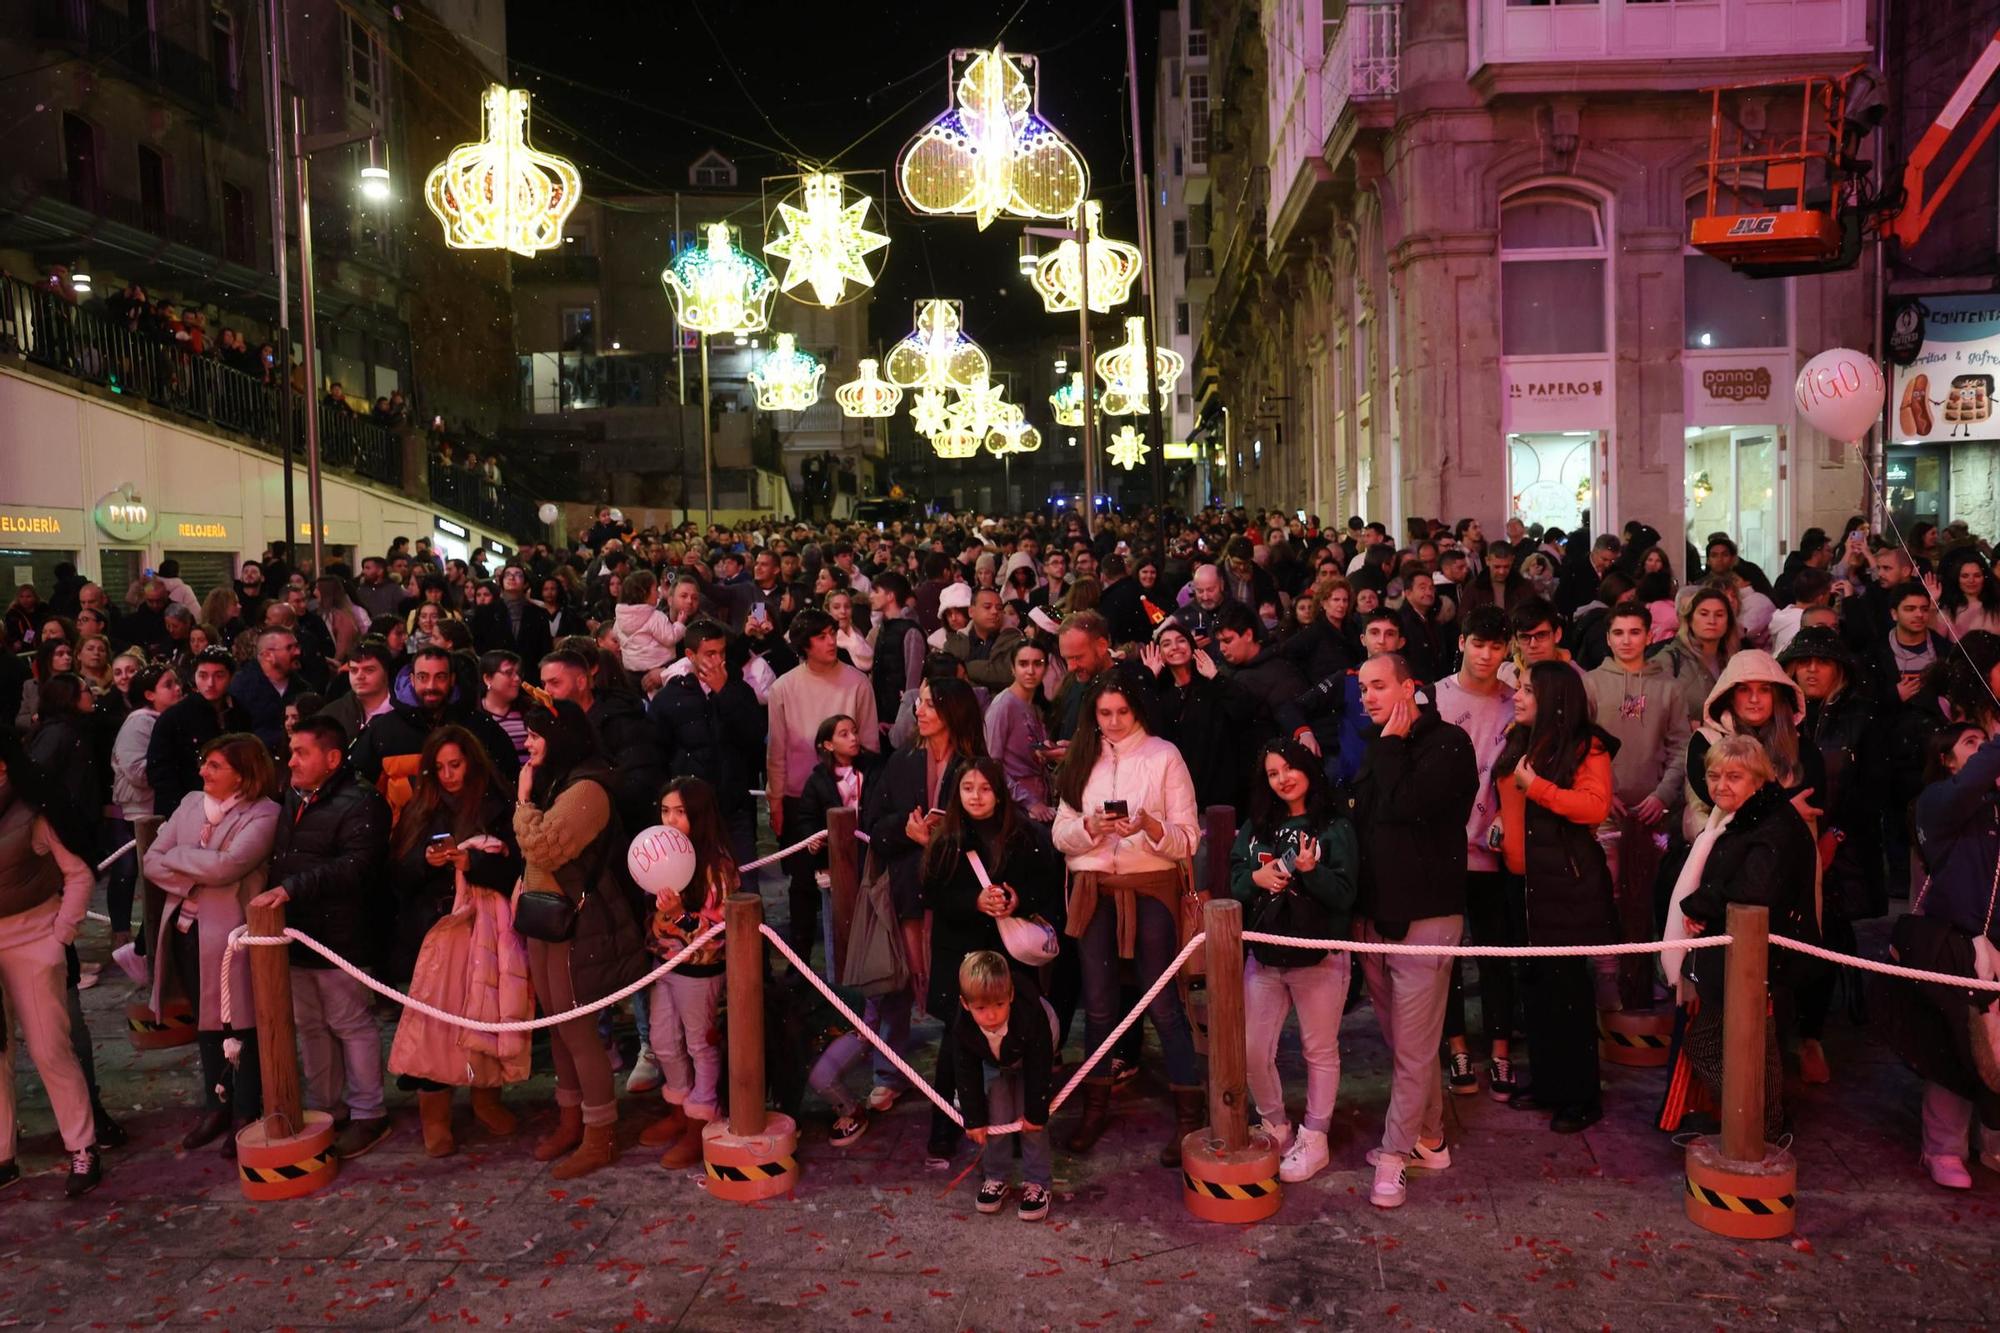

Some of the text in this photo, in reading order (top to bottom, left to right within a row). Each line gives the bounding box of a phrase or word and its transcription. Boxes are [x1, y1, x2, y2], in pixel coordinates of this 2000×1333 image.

[1727, 217, 1776, 236] JLG
[1705, 371, 1754, 386] panna
[1528, 382, 1590, 396] PAPERO
[1711, 382, 1768, 399] fragola
[179, 523, 227, 537] RELOJERÍA
